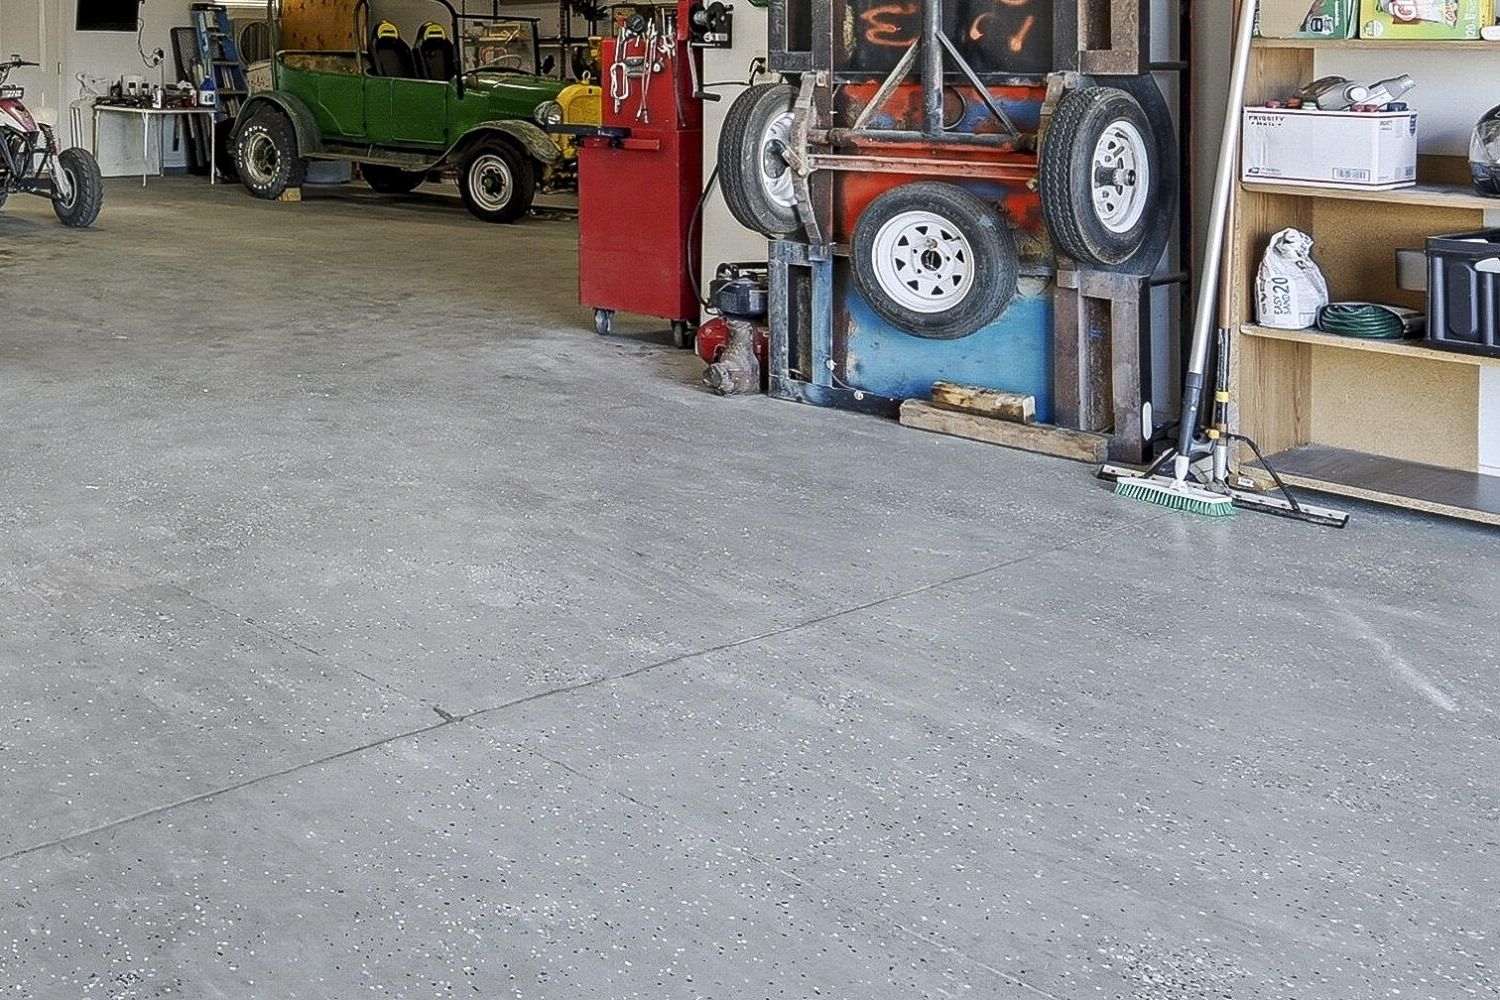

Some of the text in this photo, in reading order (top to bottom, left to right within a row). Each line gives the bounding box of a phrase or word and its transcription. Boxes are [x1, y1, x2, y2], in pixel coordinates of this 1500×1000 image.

[1271, 277, 1290, 294] 20
[1273, 295, 1284, 315] EASY
[1282, 294, 1292, 315] SAND
